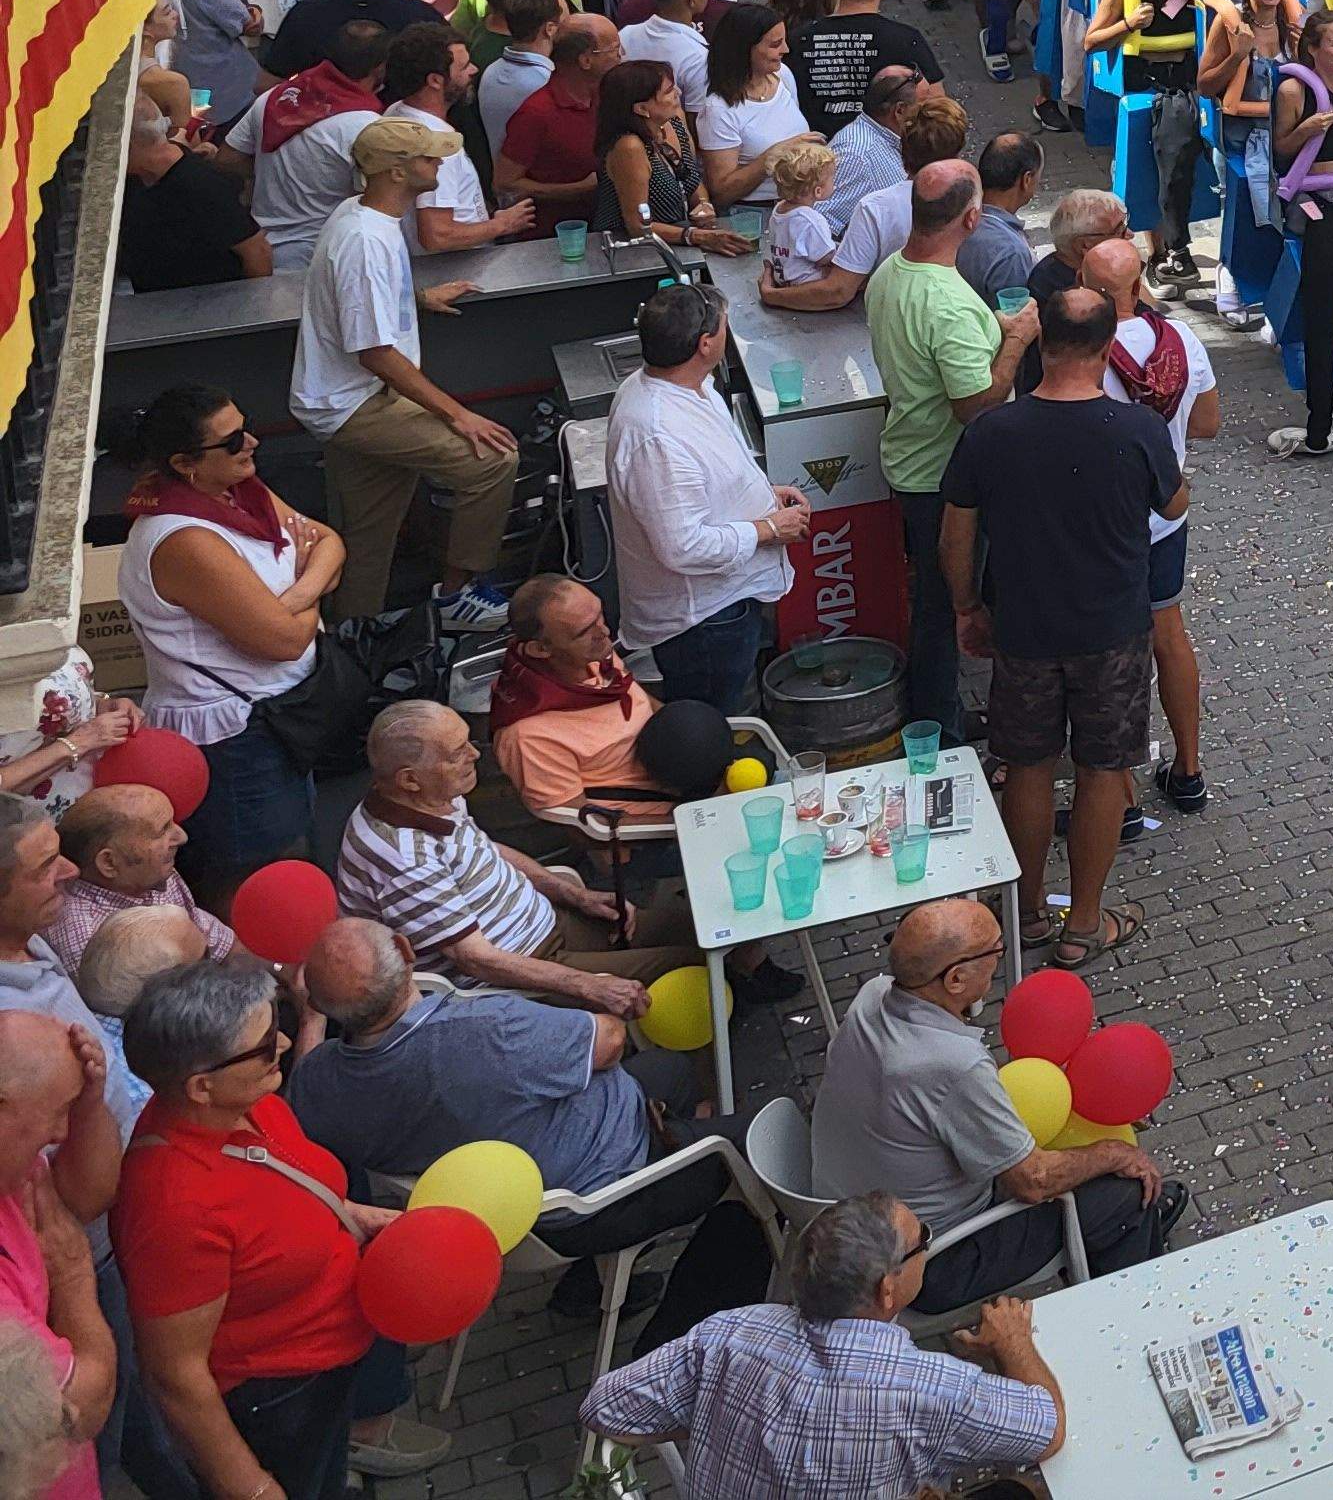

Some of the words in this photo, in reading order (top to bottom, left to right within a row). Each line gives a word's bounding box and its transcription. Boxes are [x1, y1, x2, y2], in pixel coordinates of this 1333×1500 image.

[811, 459, 842, 471] 1900
[812, 520, 857, 639] MBAR
[97, 609, 130, 623] VAS
